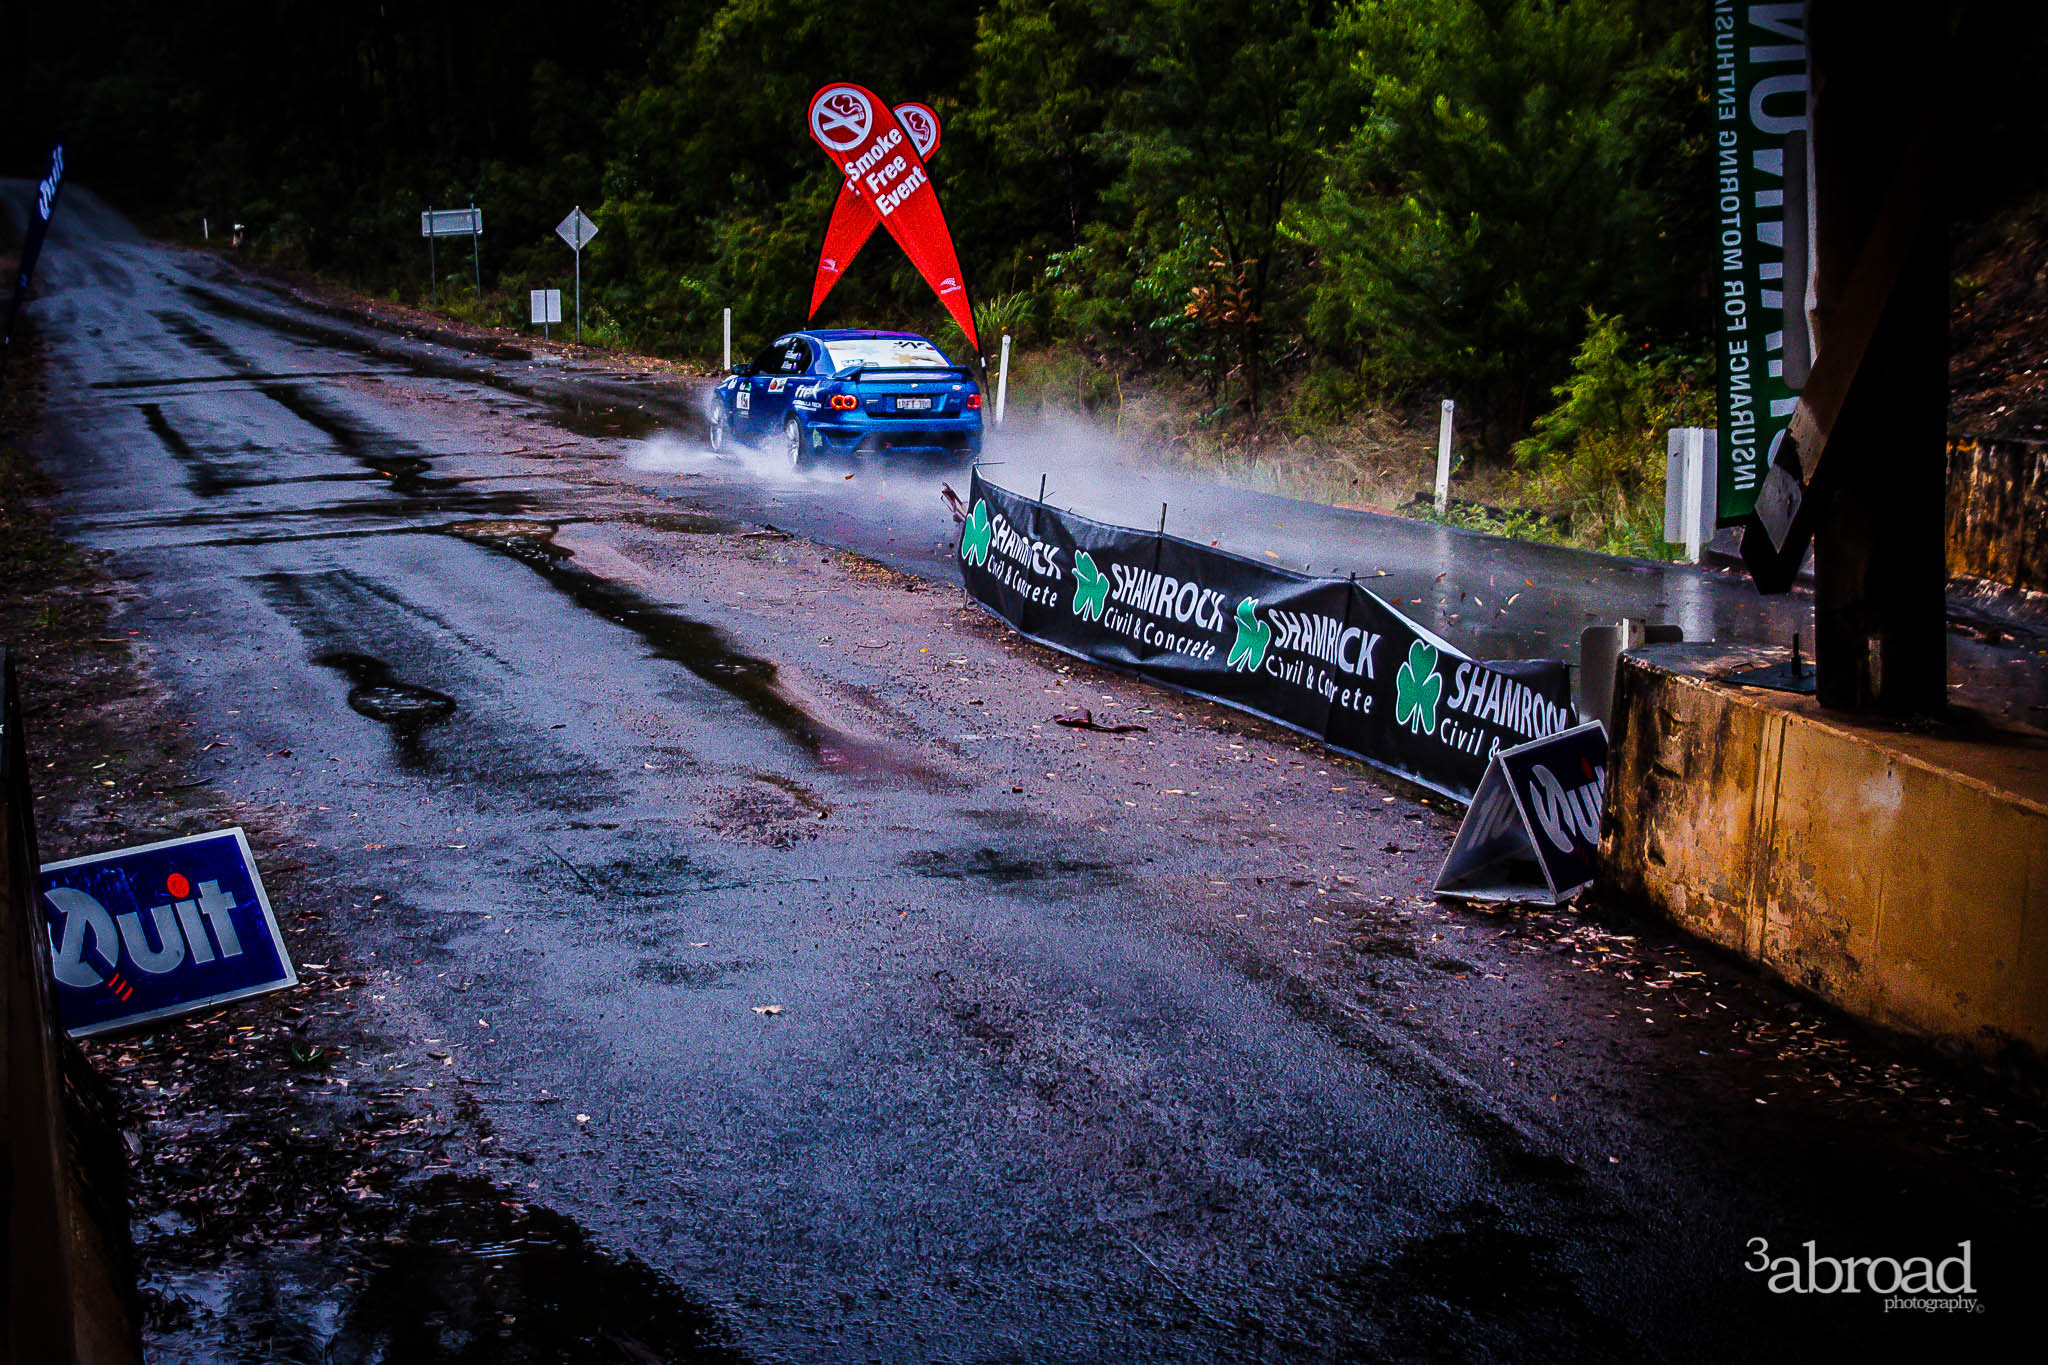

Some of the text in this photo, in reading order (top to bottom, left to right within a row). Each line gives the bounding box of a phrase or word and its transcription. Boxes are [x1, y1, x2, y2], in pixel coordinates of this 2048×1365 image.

[845, 128, 902, 181] Smoke
[866, 155, 907, 194] Free
[875, 165, 927, 216] Event
[992, 513, 1062, 581] SHAMRCK
[1004, 565, 1013, 586] &
[1111, 563, 1225, 633] SHAMROCK
[1104, 607, 1216, 661] Civil & Concrete
[1265, 654, 1373, 714] Civil & Corete
[1440, 718, 1485, 756] Civil
[45, 873, 243, 988] Quit
